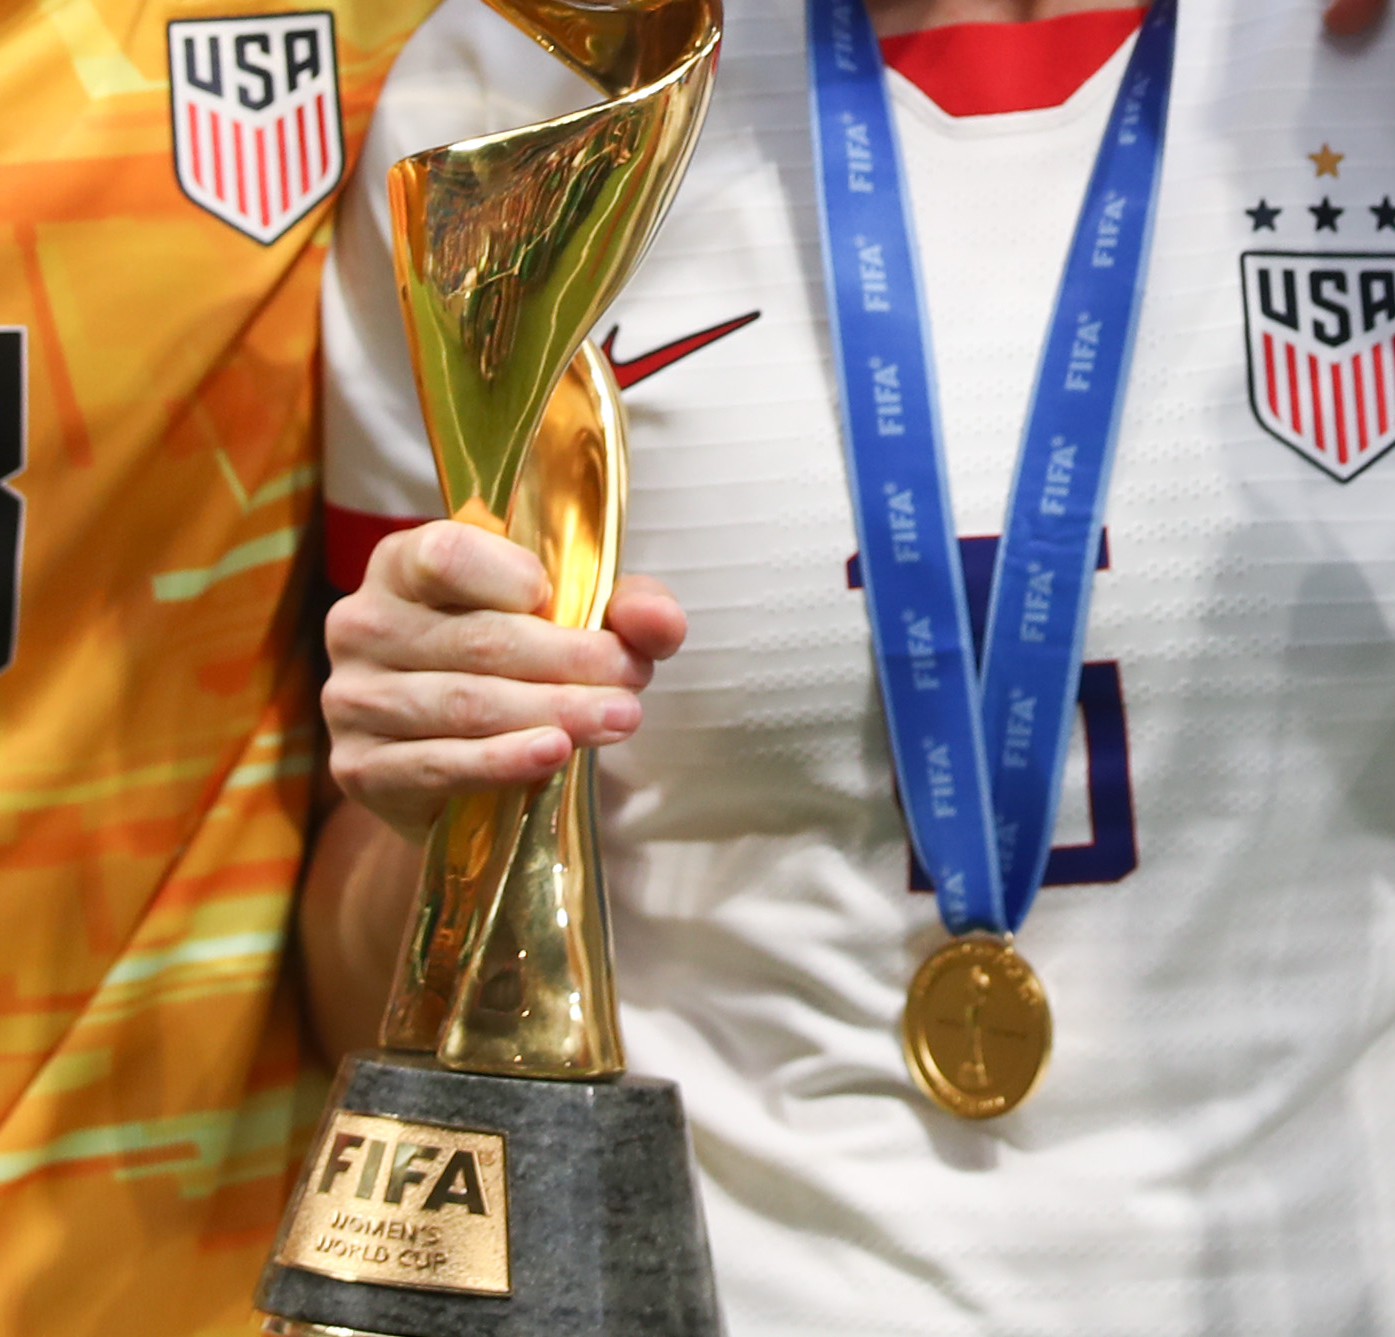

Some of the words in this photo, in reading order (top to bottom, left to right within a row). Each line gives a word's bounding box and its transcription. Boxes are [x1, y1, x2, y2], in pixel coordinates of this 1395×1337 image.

[184, 29, 321, 111] USA
[847, 123, 875, 194] FIFA
[1092, 197, 1127, 269] FIFA
[860, 244, 891, 313] FIFA
[1063, 320, 1104, 393] FIFA
[873, 363, 905, 436] FIFA
[1041, 444, 1079, 516] FIFA
[888, 489, 920, 563] FIFA
[1020, 569, 1057, 643] FIFA
[908, 616, 941, 691] FIFA
[1003, 696, 1037, 769] FIFA
[926, 743, 957, 819] FIFA
[317, 1132, 490, 1216] FIFA
[315, 1235, 390, 1265] WORLD
[398, 1249, 450, 1271] CUP
[331, 1210, 442, 1247] WOMEN'S
